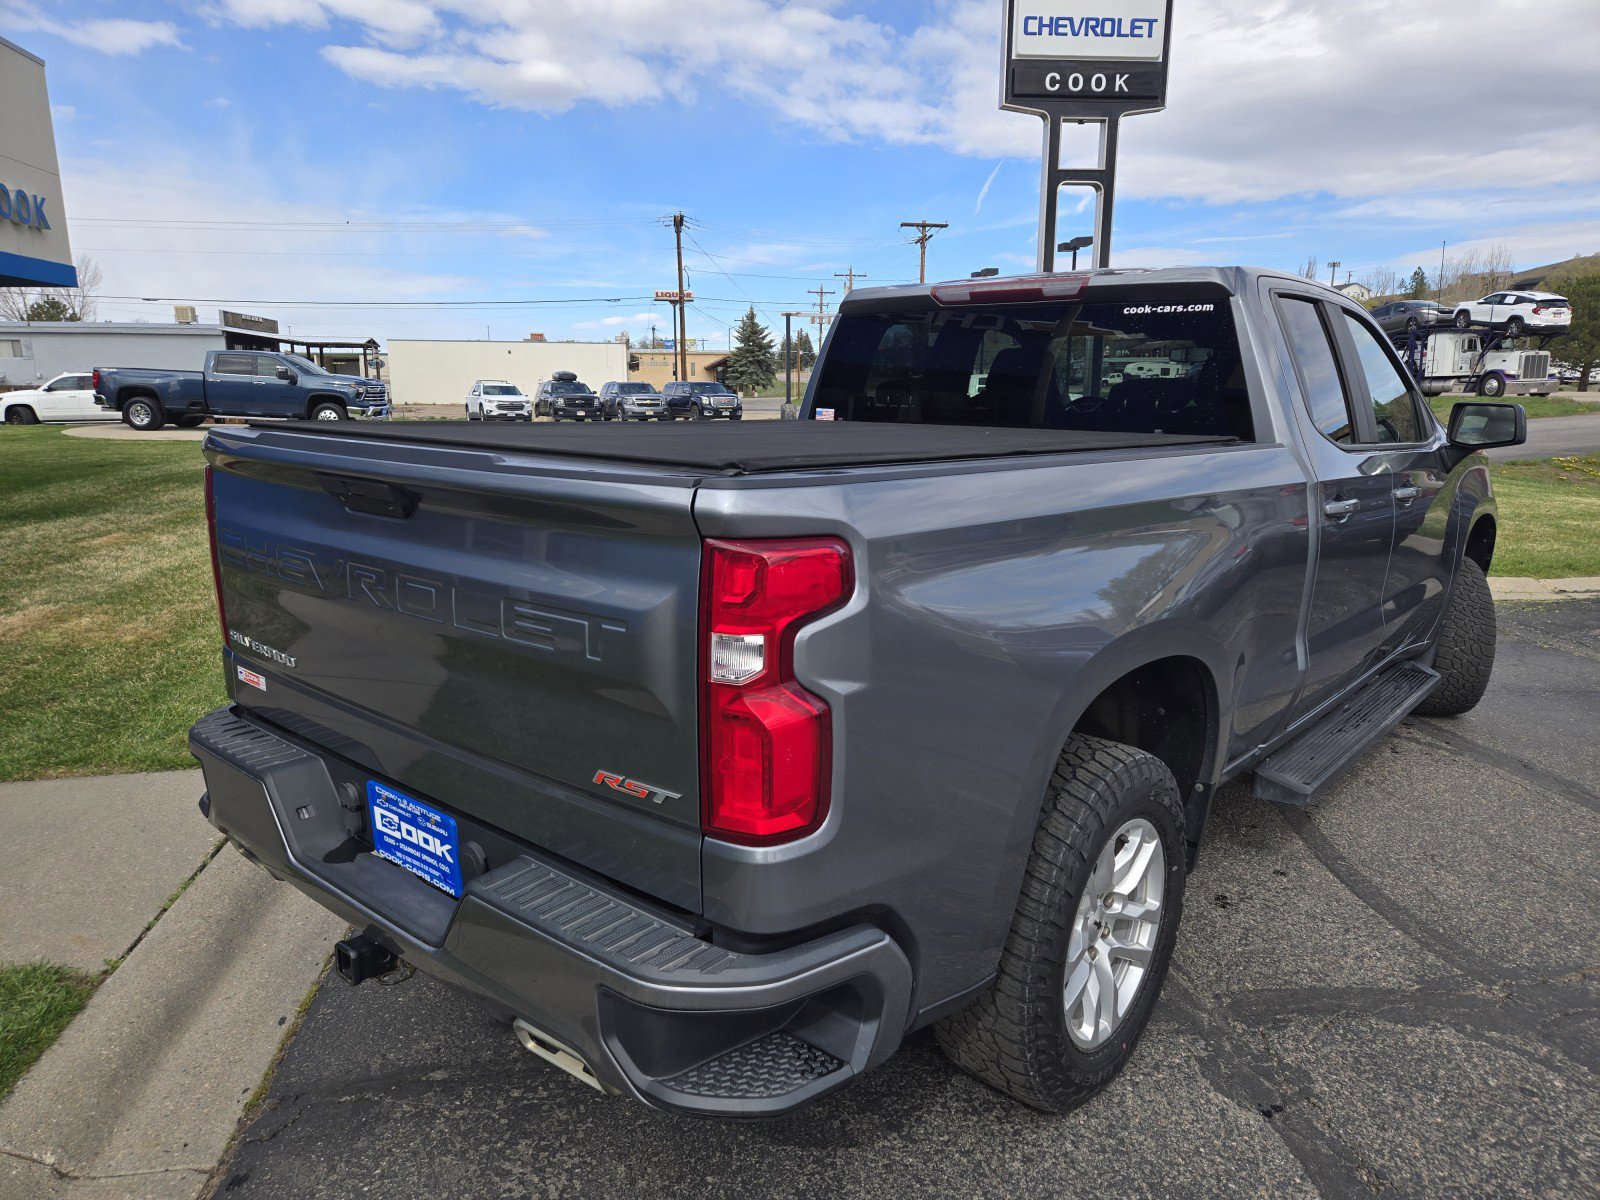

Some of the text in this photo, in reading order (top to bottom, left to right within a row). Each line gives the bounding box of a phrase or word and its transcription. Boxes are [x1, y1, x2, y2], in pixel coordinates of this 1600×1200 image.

[1023, 15, 1158, 38] CHEVROLET
[1045, 72, 1130, 92] COOK
[1123, 303, 1214, 315] cook-cars.com
[219, 526, 627, 662] CHEVROLET
[229, 629, 297, 668] SILVERADO
[592, 769, 683, 805] RST
[373, 805, 455, 864] COOK
[379, 849, 456, 896] COOK-CARS.COM
